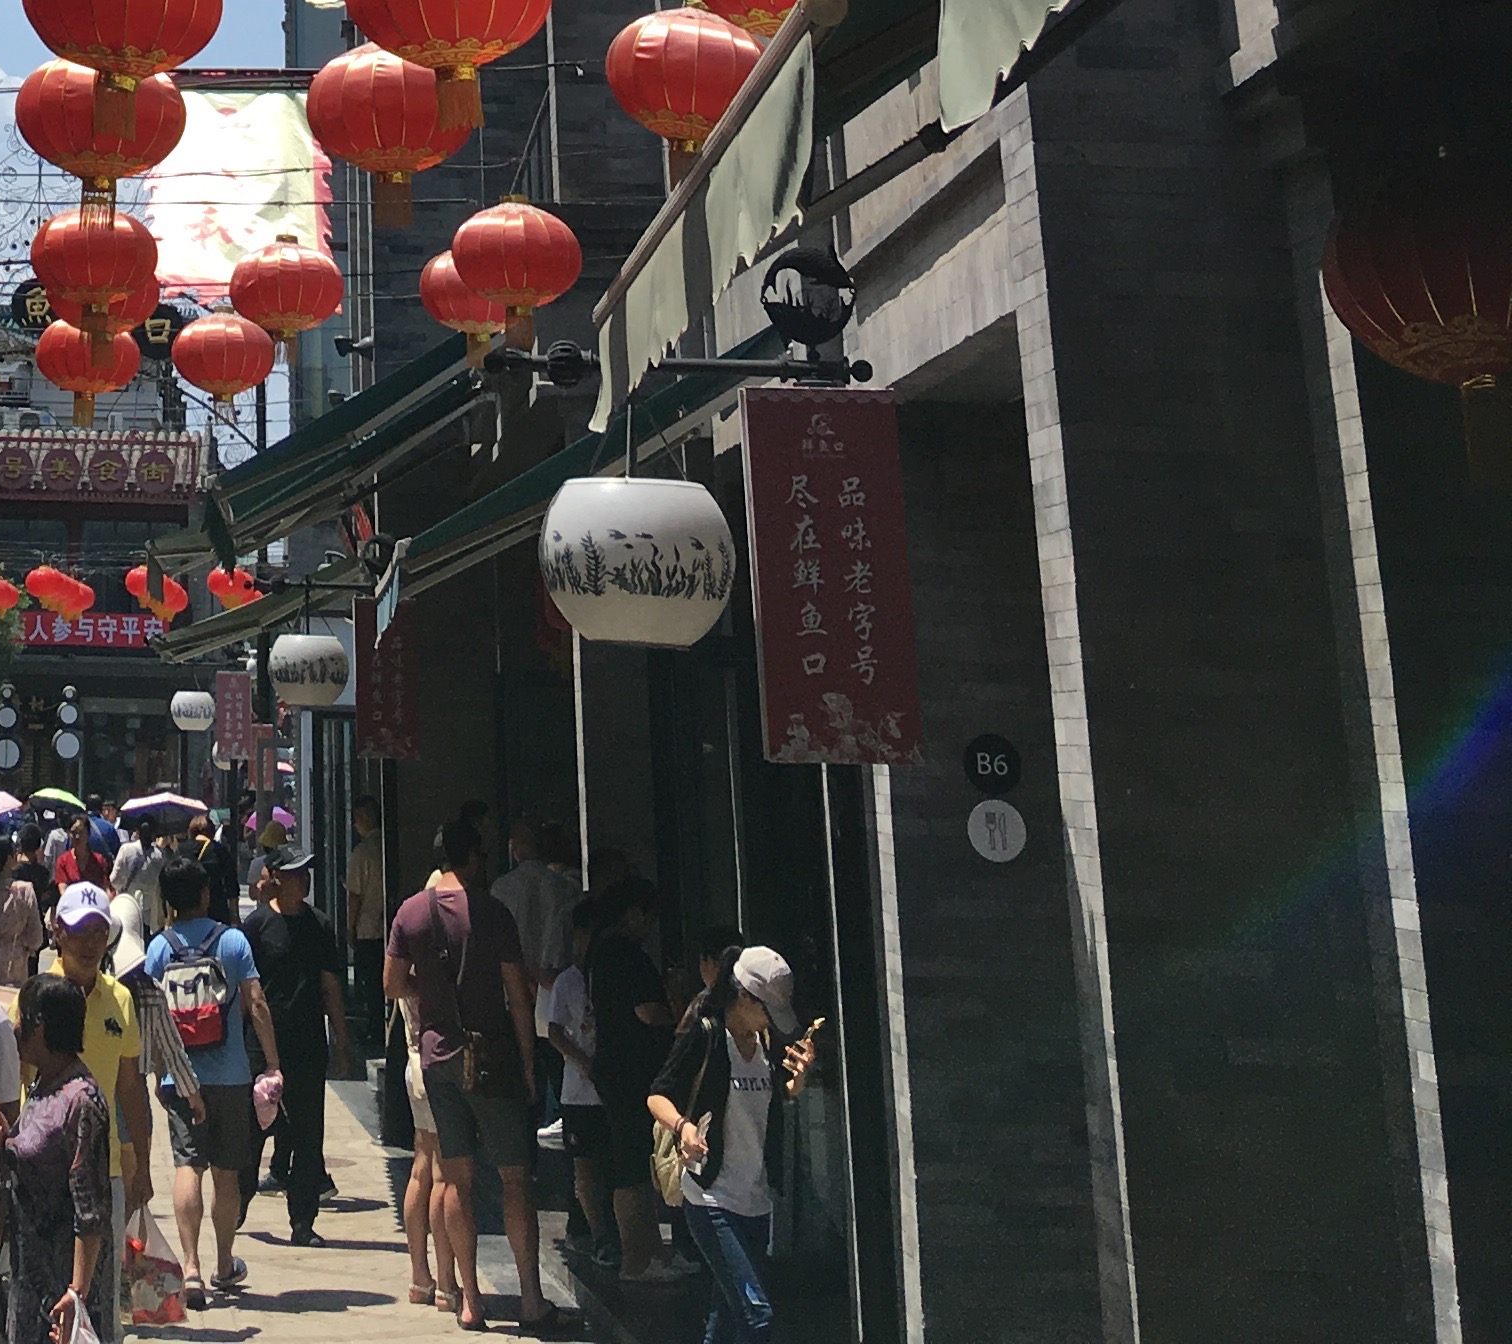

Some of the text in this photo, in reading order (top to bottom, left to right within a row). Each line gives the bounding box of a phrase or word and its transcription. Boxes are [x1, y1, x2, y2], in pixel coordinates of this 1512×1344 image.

[19, 615, 165, 645] 人参与守平安
[784, 473, 829, 677] 尽在鲜鱼口
[837, 475, 879, 687] 品味老字号
[975, 752, 1009, 776] B6
